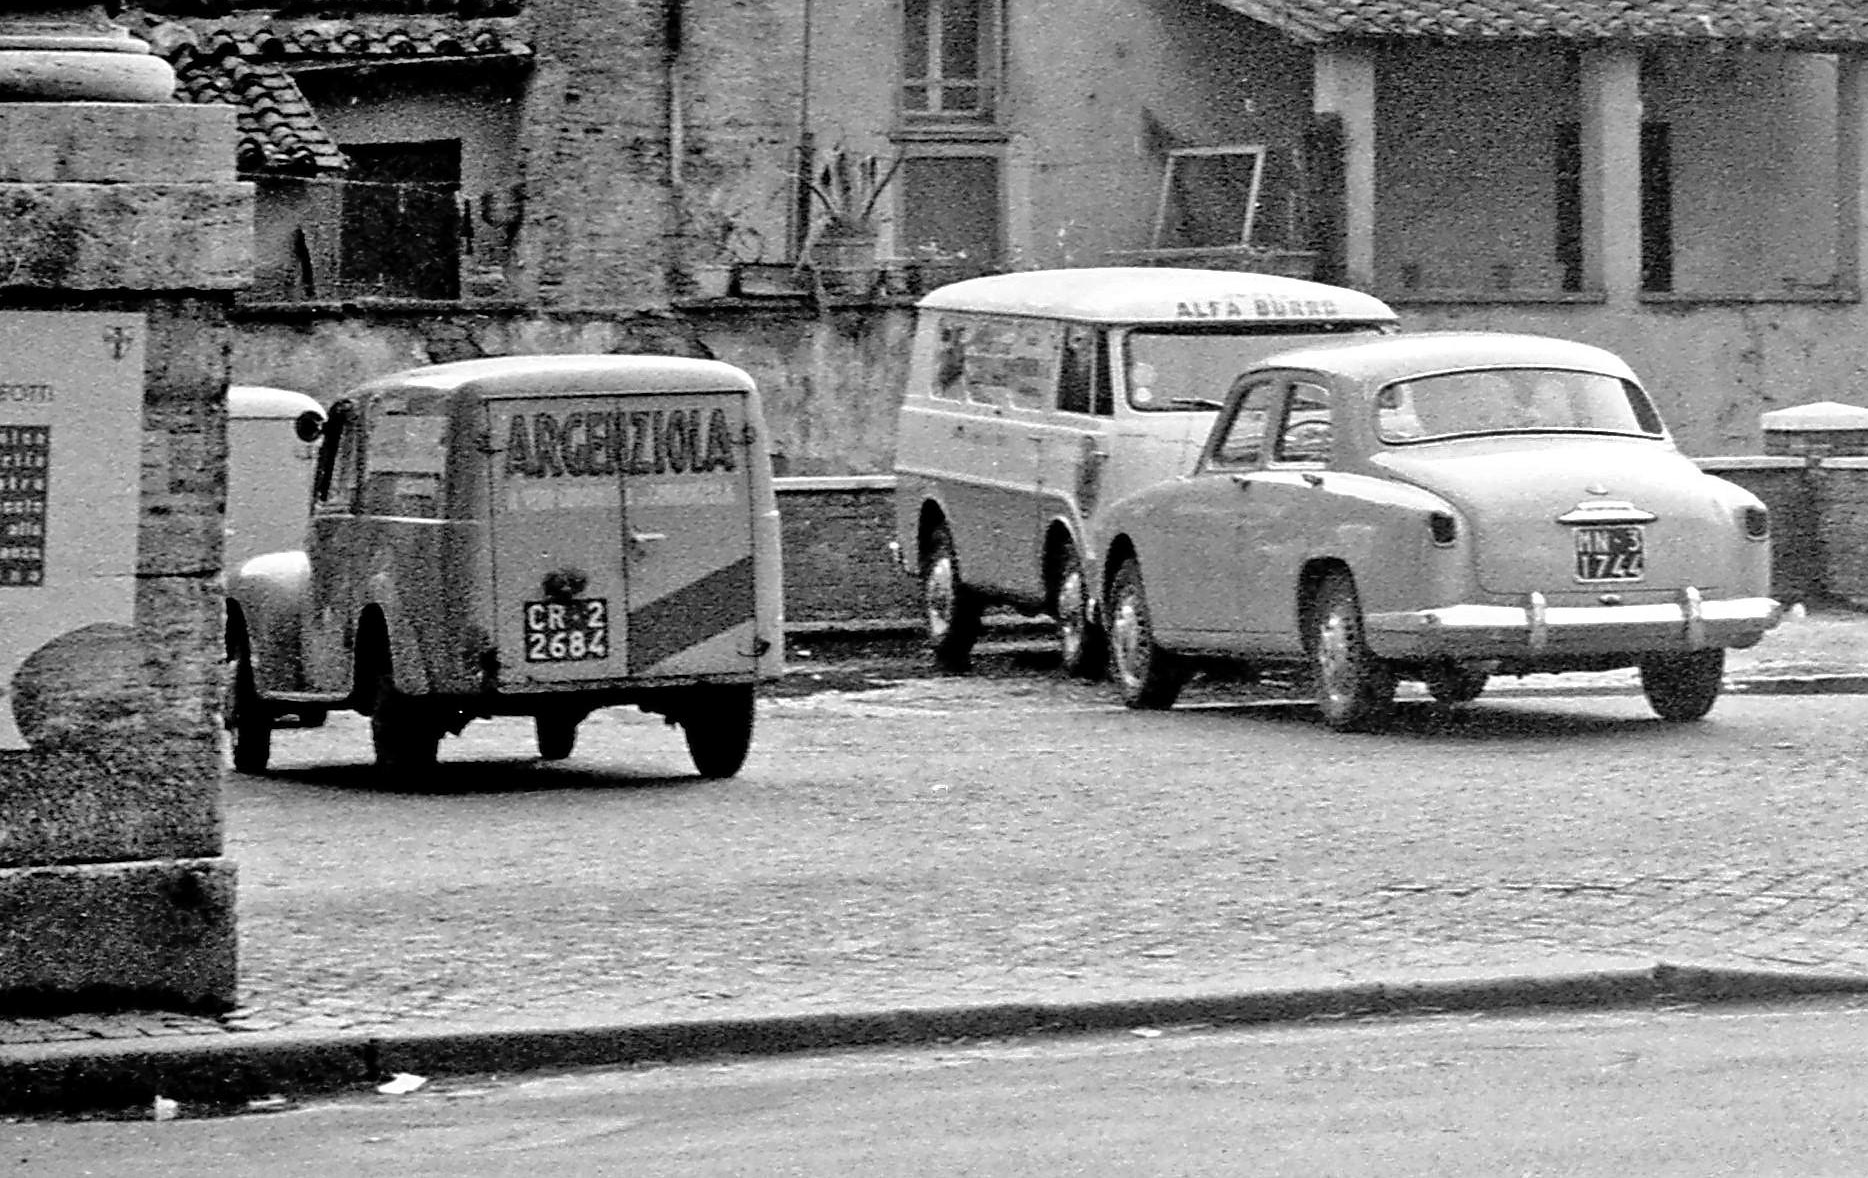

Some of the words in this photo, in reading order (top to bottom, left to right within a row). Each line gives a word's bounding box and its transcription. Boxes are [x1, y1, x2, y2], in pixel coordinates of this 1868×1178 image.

[1176, 301, 1242, 318] ALFA
[504, 407, 737, 478] ARGENZIOLA
[1582, 553, 1641, 578] 1744
[527, 603, 567, 631] CR
[528, 629, 606, 660] 2684
